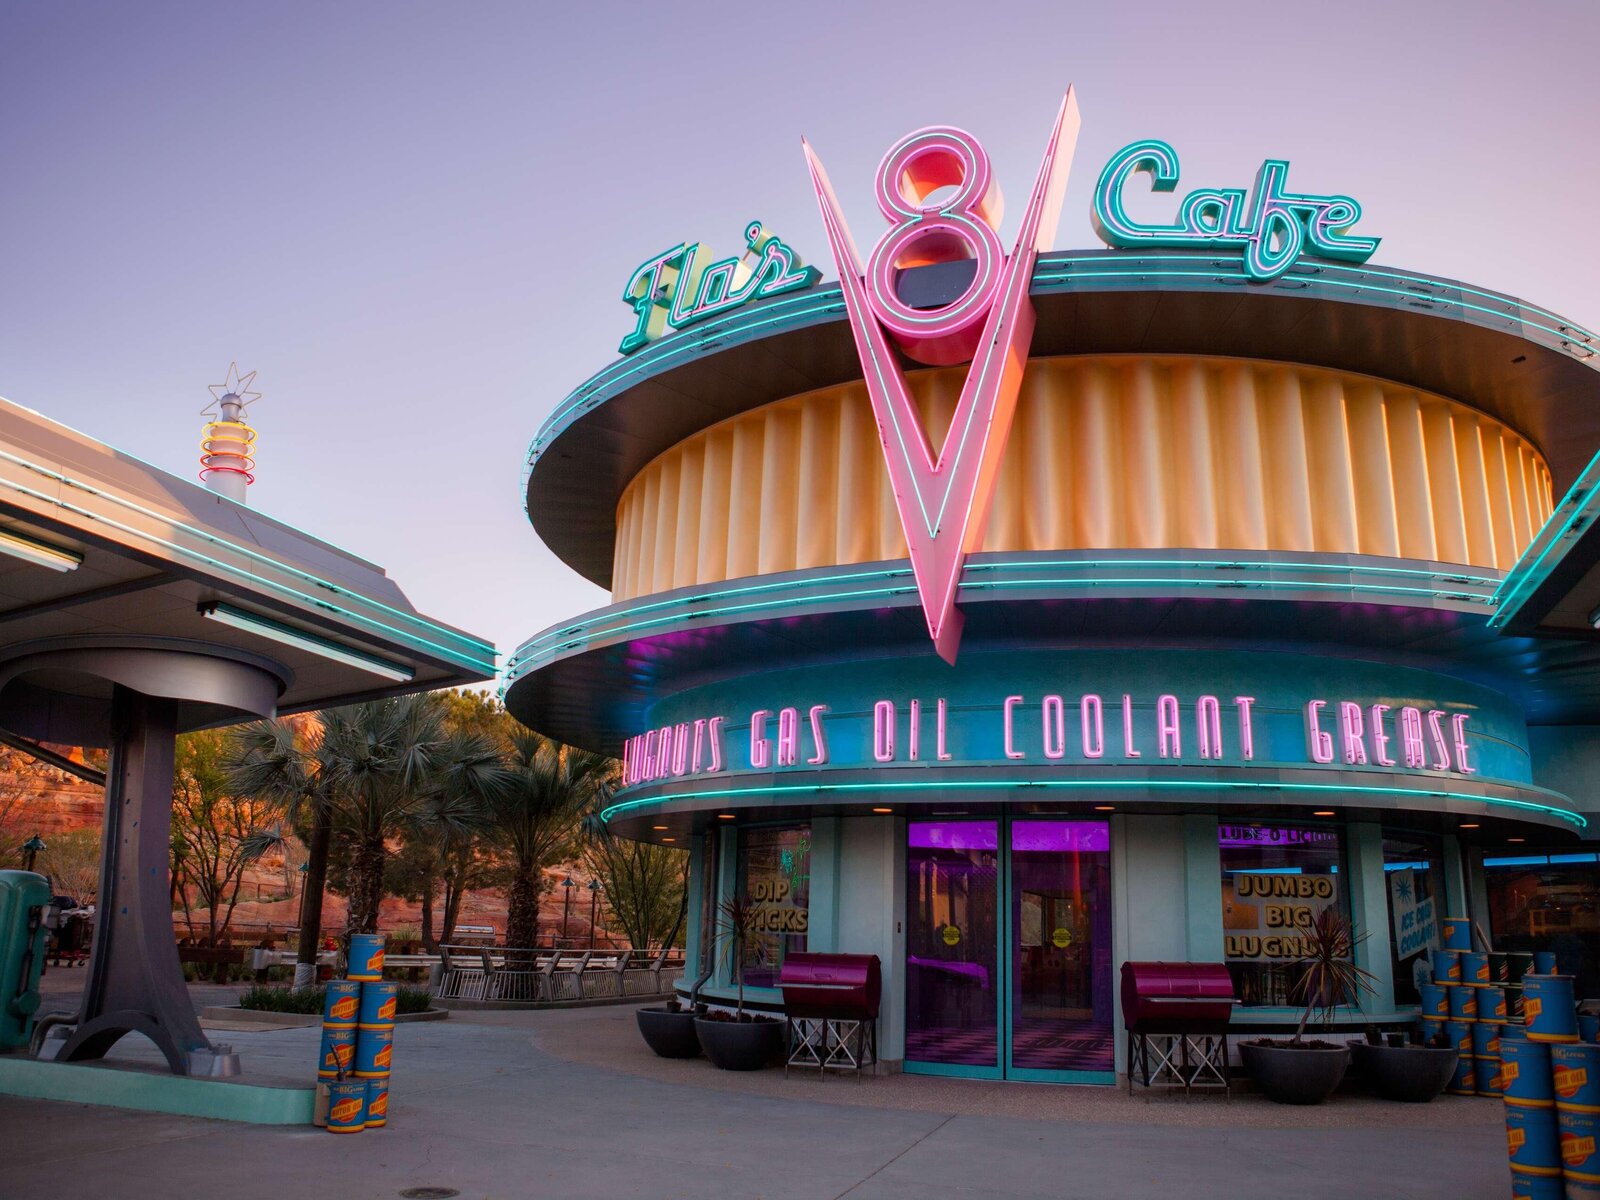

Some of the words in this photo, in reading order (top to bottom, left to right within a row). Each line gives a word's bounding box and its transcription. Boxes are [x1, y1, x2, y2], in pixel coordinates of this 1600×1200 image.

[619, 220, 823, 356] Flo's
[1091, 139, 1382, 283] Cafe
[621, 716, 726, 788] LUGNUTS
[750, 704, 830, 769] GAS
[874, 697, 953, 763] OIL
[1003, 694, 1256, 761] COOLANT
[1305, 699, 1477, 775] GREASE
[754, 879, 790, 903] DIP
[1238, 874, 1334, 899] JUMBO
[1264, 904, 1314, 929] BIG
